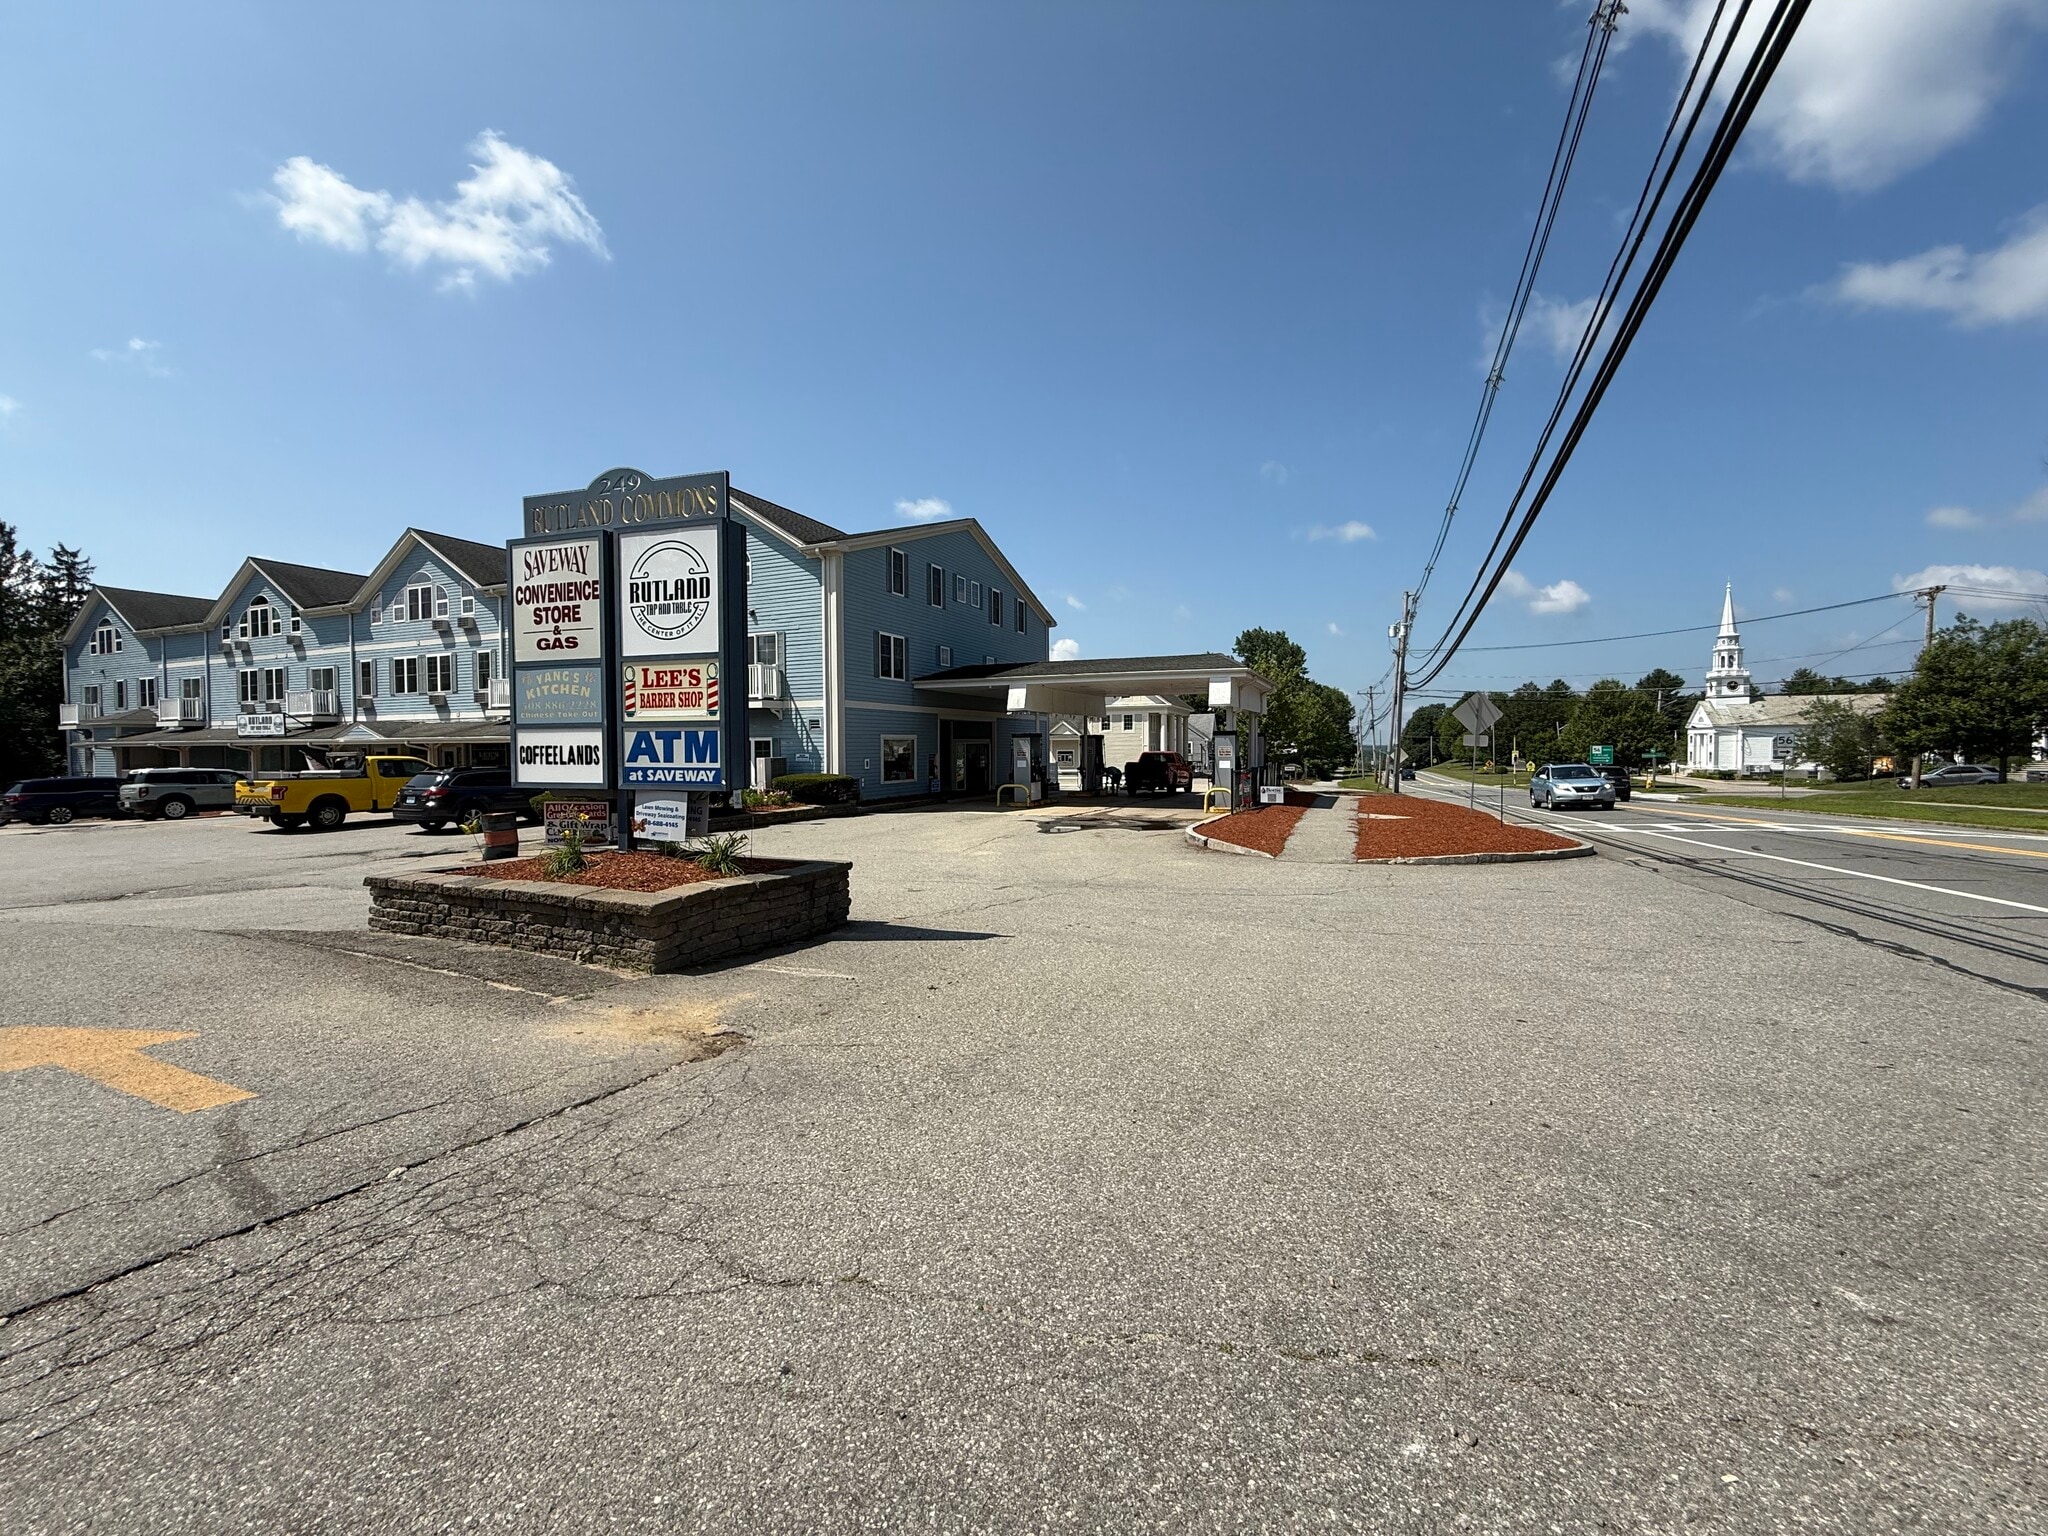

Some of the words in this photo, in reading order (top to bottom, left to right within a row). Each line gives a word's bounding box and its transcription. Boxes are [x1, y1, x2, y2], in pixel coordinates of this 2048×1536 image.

[600, 474, 641, 494] 249
[532, 498, 614, 534] RUTLAND
[620, 484, 718, 524] COMMONS
[524, 545, 590, 582] SAVEWAY
[515, 579, 600, 606] CONVENIENCE
[629, 576, 711, 604] RUTLAND
[533, 604, 582, 626] STORE
[646, 604, 658, 616] TAP
[658, 602, 671, 615] AND
[672, 601, 692, 614] TABLE
[552, 625, 562, 635] &
[636, 612, 647, 626] THE
[647, 626, 674, 637] CENTER
[676, 627, 685, 635] OF
[686, 621, 694, 629] IT
[694, 608, 705, 622] ALL
[536, 636, 579, 651] GAS
[641, 668, 702, 688] LEE'S
[525, 684, 591, 700] KITCHEN
[640, 692, 676, 709] BARBER
[678, 691, 704, 708] SHOP
[626, 730, 718, 763] ATM
[1778, 736, 1793, 744] 56
[519, 745, 600, 766] COFFEELANDS
[628, 770, 644, 781] at
[647, 769, 716, 782] SAVEWAY
[655, 805, 674, 813] Mowing
[658, 813, 685, 821] Sealcoating
[560, 821, 578, 829] Gift
[582, 821, 608, 831] Wrap
